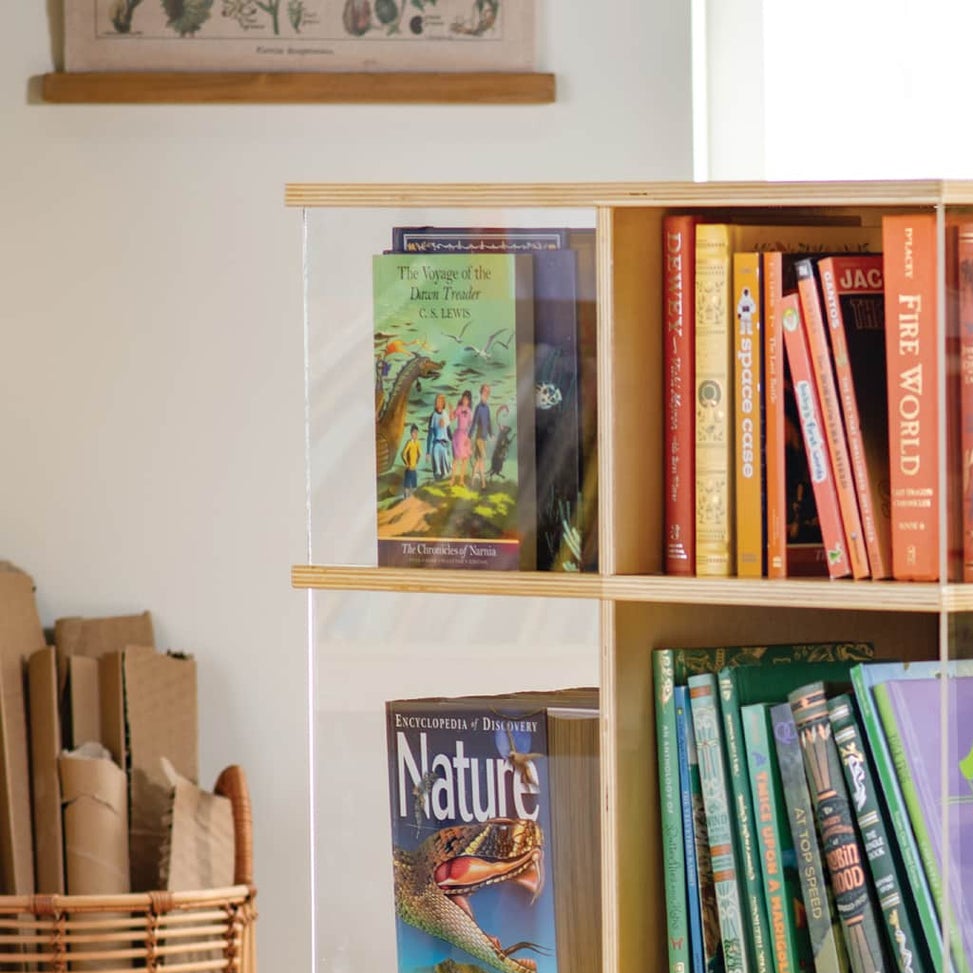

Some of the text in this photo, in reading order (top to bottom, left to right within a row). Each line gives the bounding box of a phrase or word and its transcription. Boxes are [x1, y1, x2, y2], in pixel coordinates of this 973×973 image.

[397, 265, 491, 285] The Voyage of the
[410, 285, 481, 301] Dawn Treader
[667, 232, 683, 337] DEWEY
[823, 271, 839, 329] GANTOS
[419, 307, 471, 319] C. S. LEWIS
[898, 294, 922, 356] FIRE
[737, 337, 753, 478] space case
[898, 363, 924, 476] WORLD
[806, 421, 819, 449] first
[812, 450, 825, 480] words
[401, 542, 497, 557] The Chronicles of Narnia
[395, 713, 538, 733] ENCYCLOPEDIA of DISCOVERY
[396, 731, 540, 823] Nature
[663, 740, 672, 799] ANTHOLOGY
[755, 771, 772, 823] TWICE
[760, 826, 778, 877] UPON
[793, 807, 822, 920] AT TOP SPEED
[768, 879, 780, 893] A
